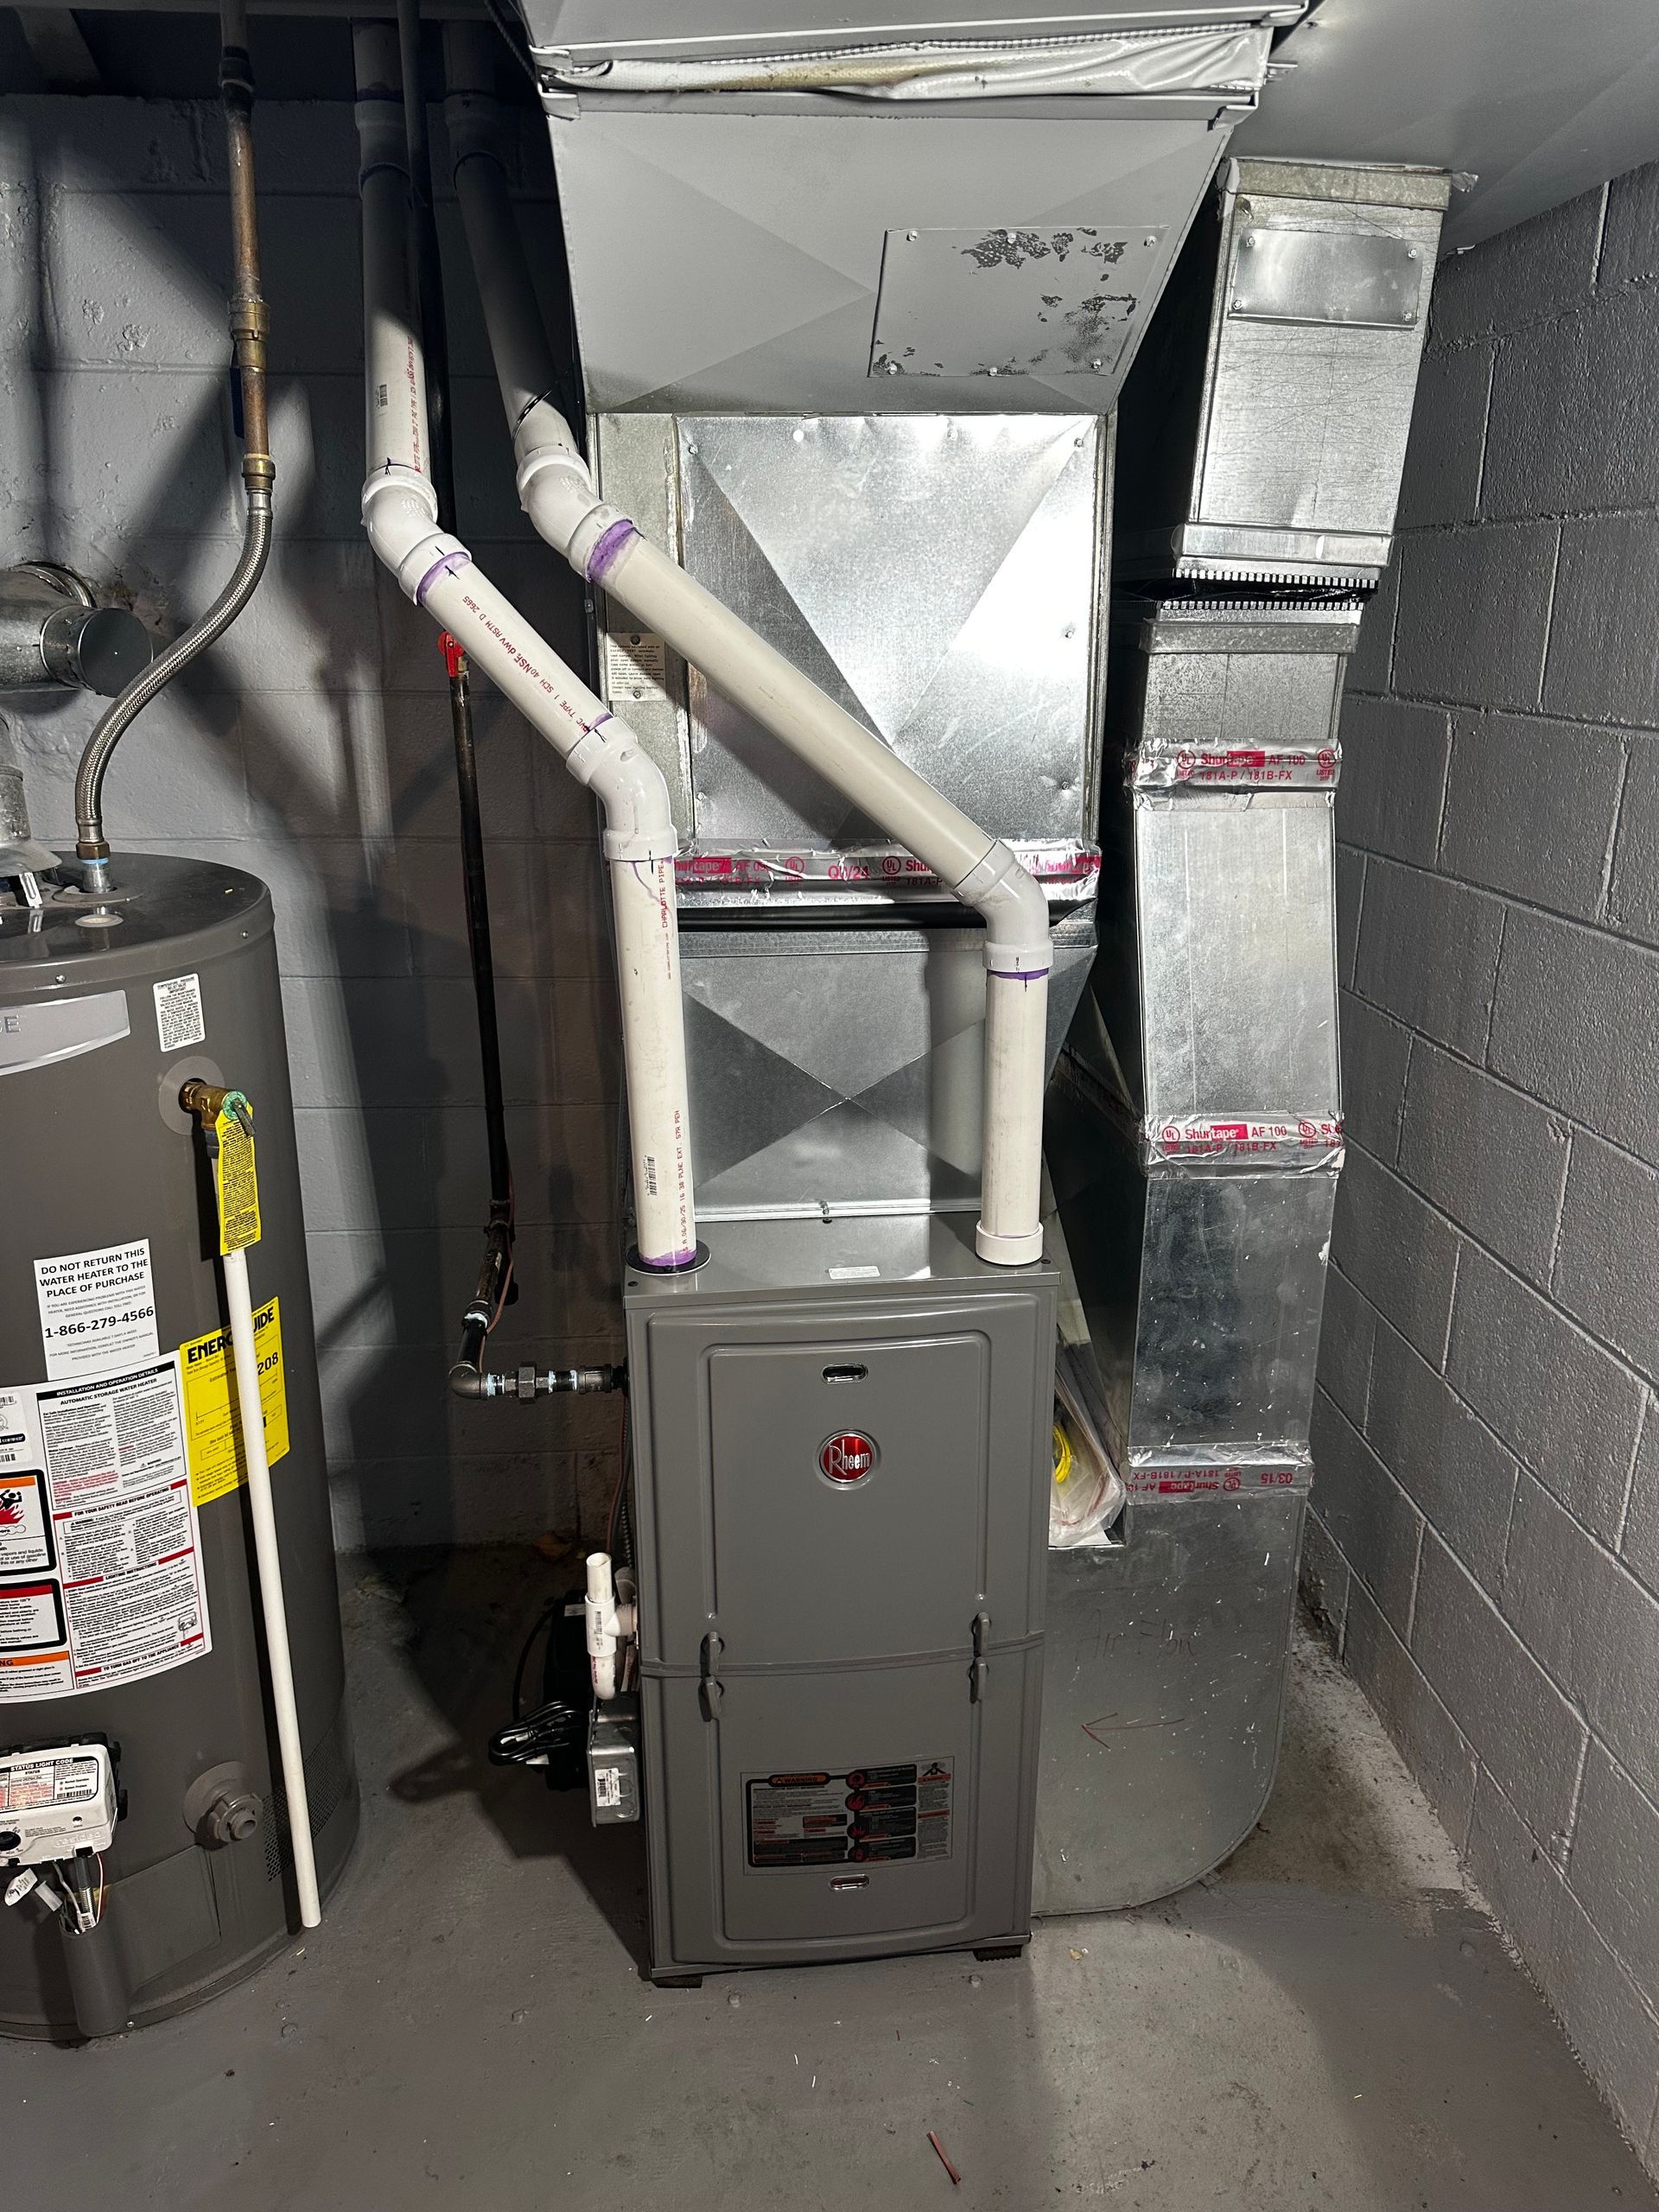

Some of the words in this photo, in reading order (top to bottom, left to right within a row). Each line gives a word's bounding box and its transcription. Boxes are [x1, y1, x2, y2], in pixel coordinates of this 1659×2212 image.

[462, 596, 480, 613] 2665
[486, 620, 502, 638] ASTM
[499, 638, 516, 654] dwv
[531, 669, 539, 677] 40
[539, 679, 554, 693] SCH
[560, 700, 576, 717] TYPE
[1268, 755, 1284, 765] AF
[1287, 755, 1306, 765] 100
[1200, 771, 1238, 780] 181A-P
[1249, 771, 1293, 780] 181B-FX
[1185, 1128, 1236, 1140] Shurtape
[1251, 1127, 1266, 1137] AF
[1268, 1126, 1287, 1136] 100
[41, 1265, 56, 1274] DO
[60, 1262, 81, 1272] NOT
[84, 1254, 122, 1268] RETURN
[124, 1248, 145, 1258] THIS
[40, 1274, 74, 1287] WATER
[78, 1268, 114, 1281] HEATER
[116, 1264, 129, 1273] TO
[131, 1259, 149, 1270] THE
[47, 1287, 77, 1297] PLACE
[79, 1283, 93, 1292] OF
[96, 1272, 144, 1289] PURCHASE
[45, 1306, 154, 1338] 1-866-279-4566
[57, 1385, 95, 1396] INSTALLATION
[109, 1375, 137, 1385] OPERATION
[138, 1368, 158, 1378] DETAILS
[60, 1395, 93, 1405] AUTOMATIC
[94, 1389, 118, 1398] STORAGE
[138, 1378, 157, 1387] HEATER
[829, 1439, 870, 1476] Rheem
[1191, 1470, 1218, 1478] 181A-P
[1261, 1473, 1293, 1484] 03/15
[146, 1487, 168, 1498] OPERATING
[157, 1644, 179, 1655] APPLIANCE
